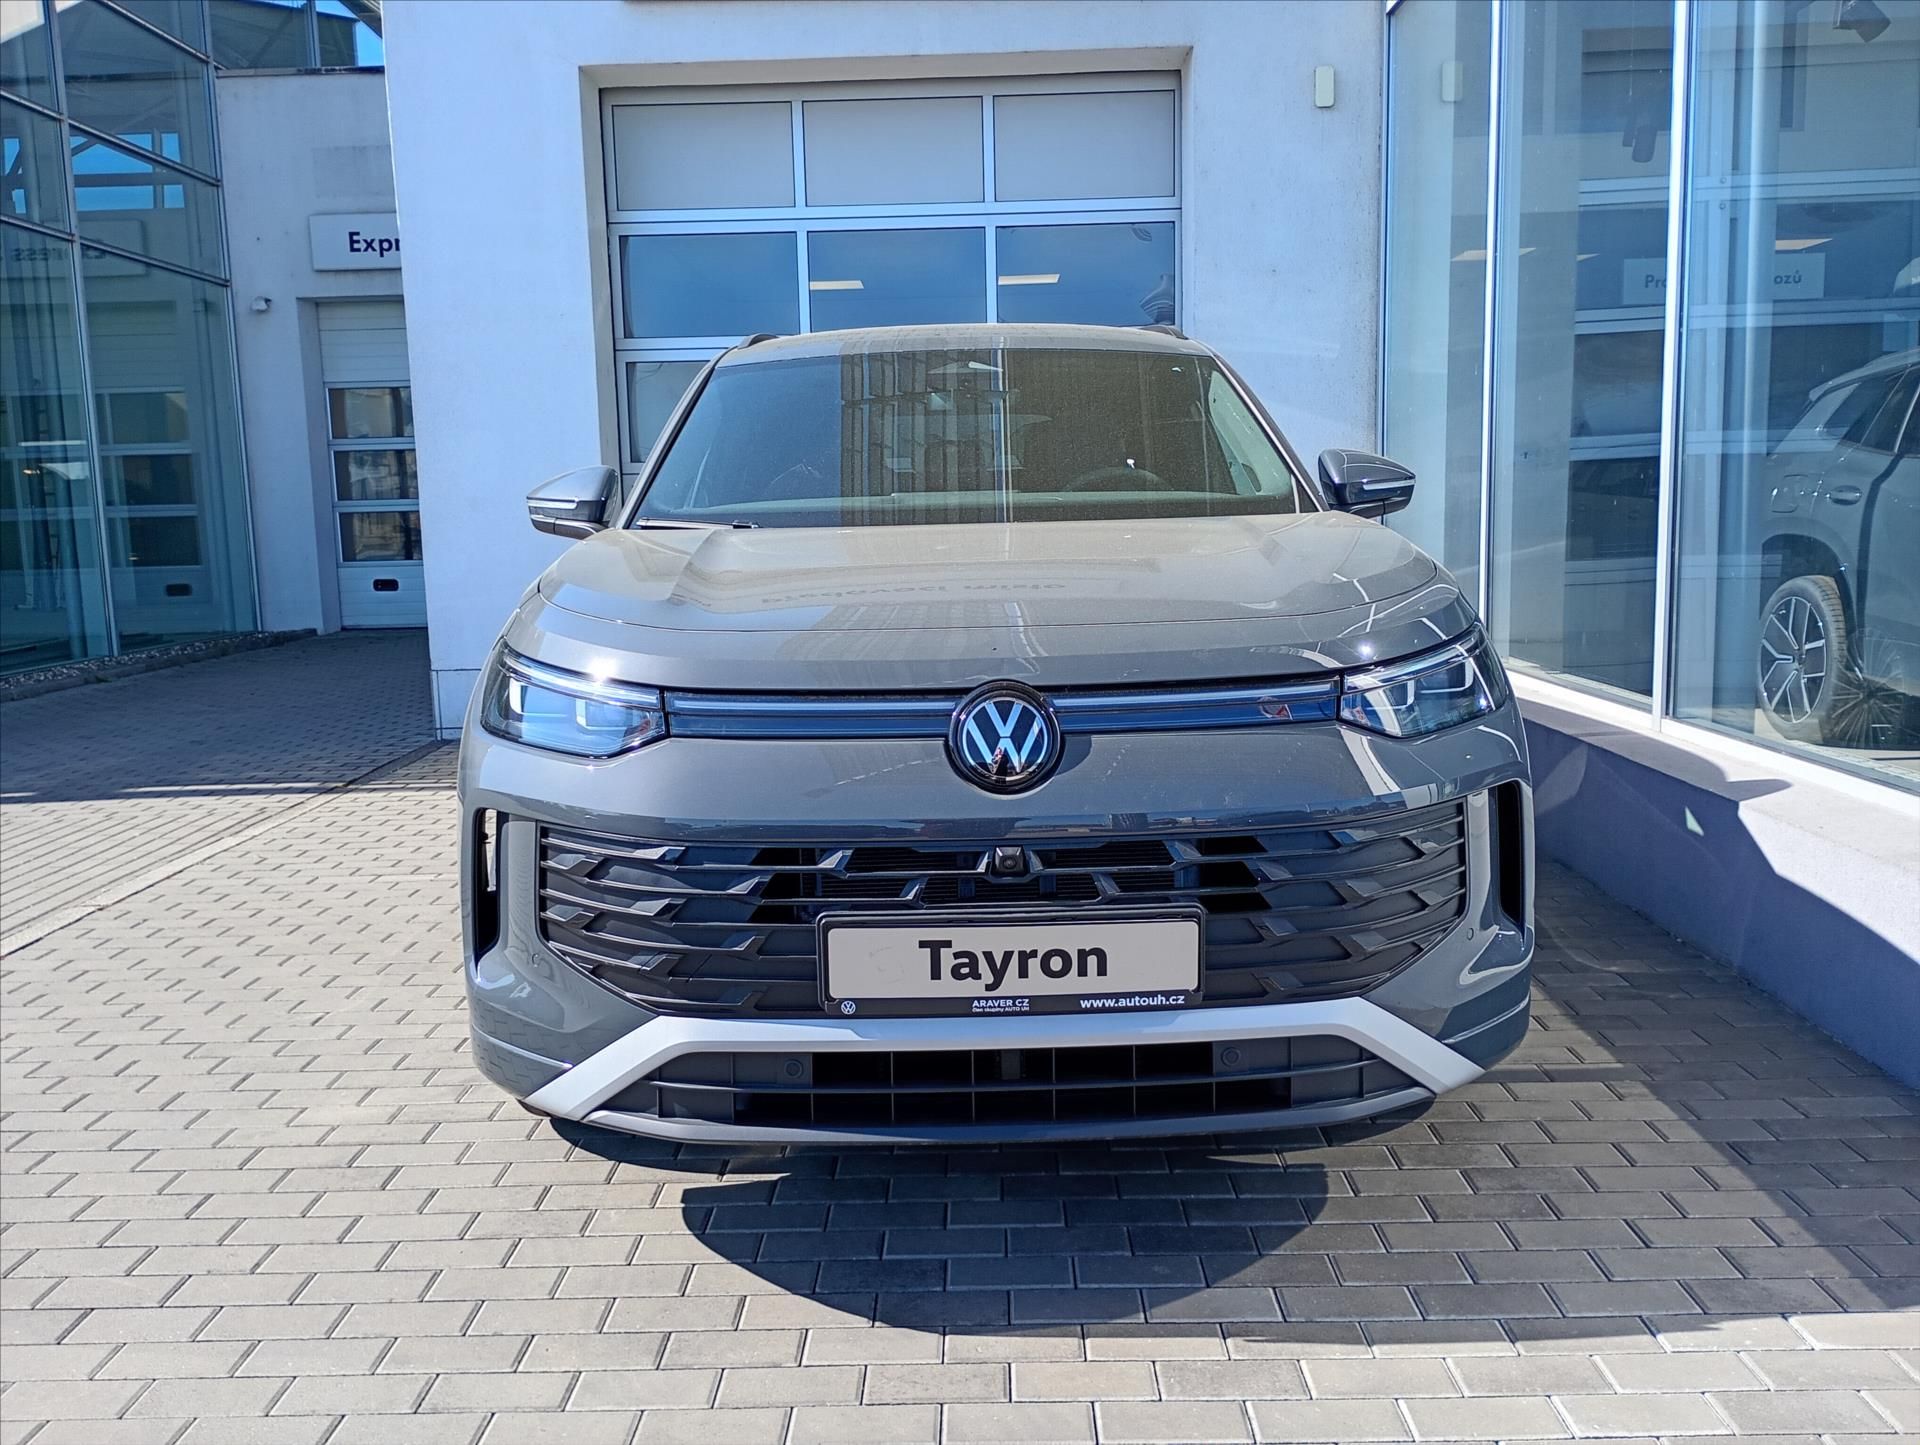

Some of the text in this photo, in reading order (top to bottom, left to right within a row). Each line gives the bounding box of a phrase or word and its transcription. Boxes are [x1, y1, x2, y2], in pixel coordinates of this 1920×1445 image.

[1773, 269, 1802, 285] ozů
[918, 940, 1108, 992] Tayron
[1015, 998, 1030, 1006] CZ
[1080, 994, 1185, 1008] www.autouh.cz
